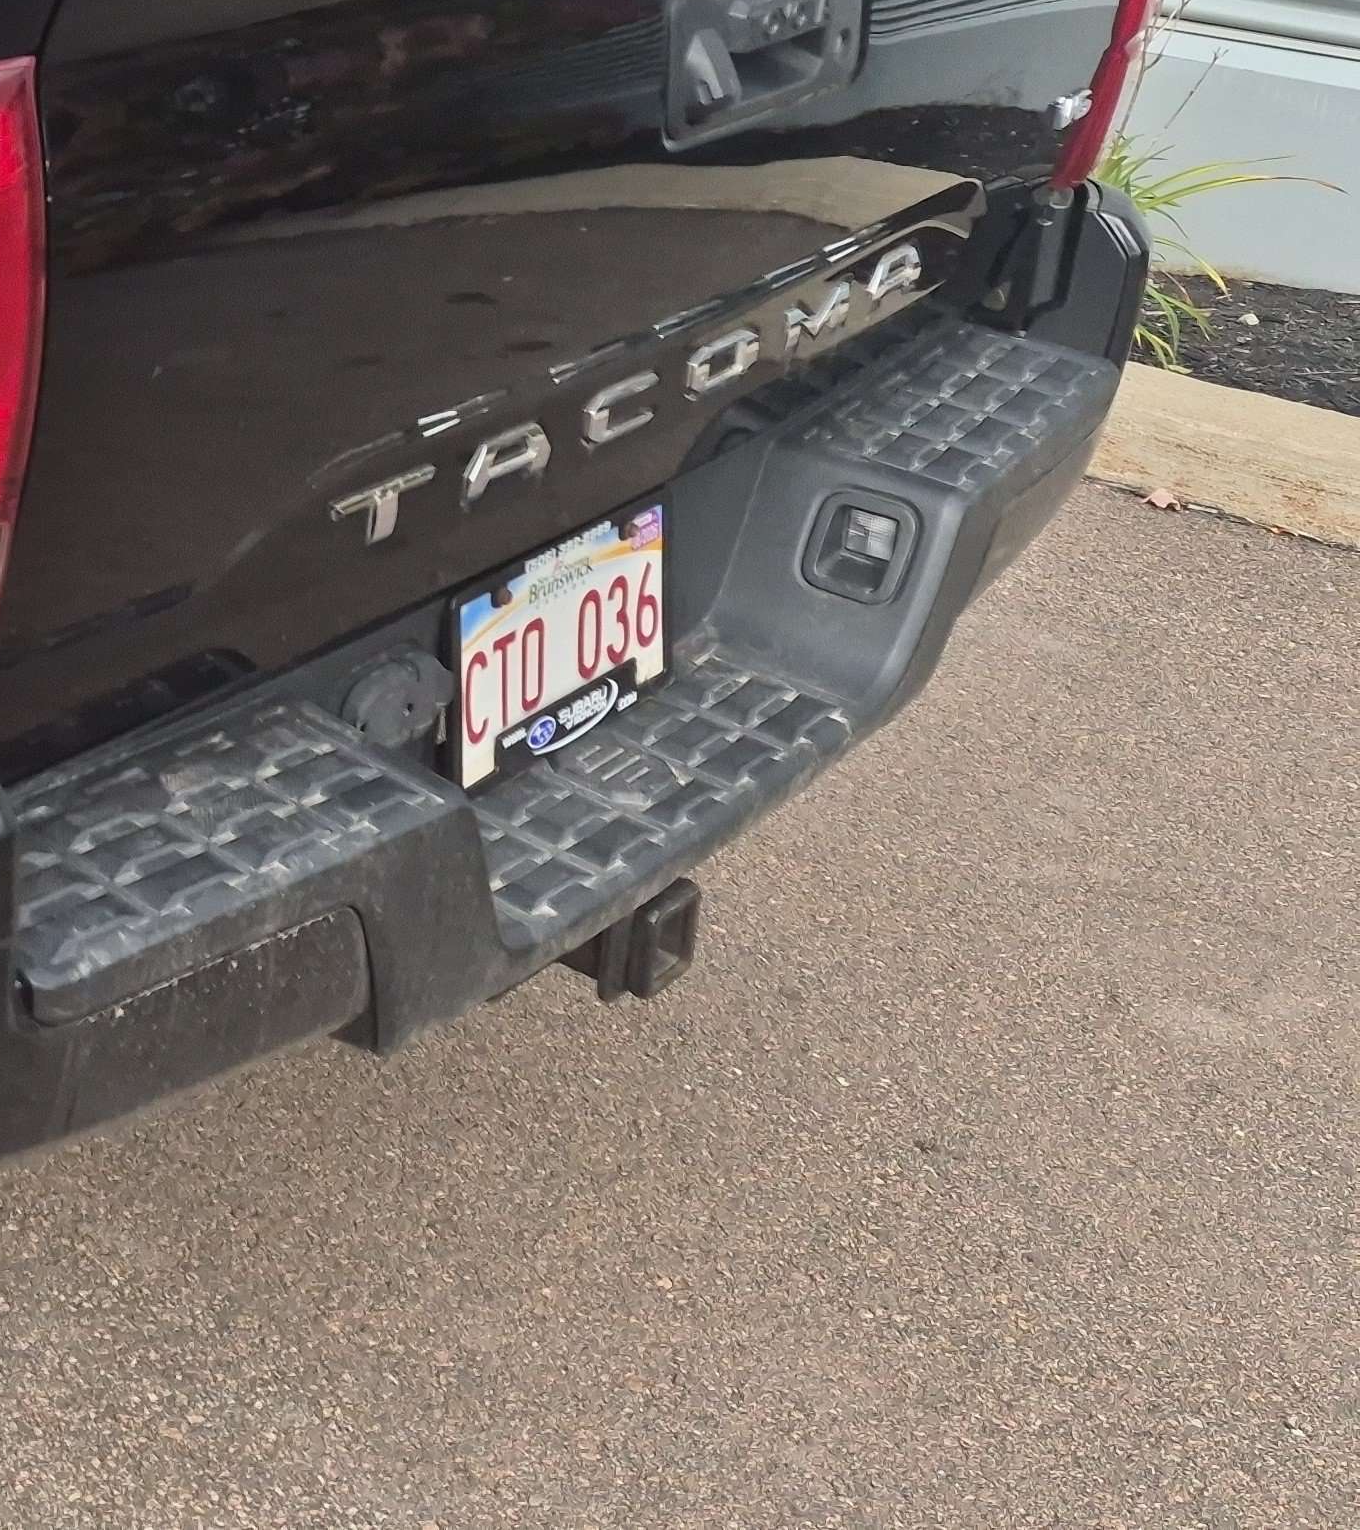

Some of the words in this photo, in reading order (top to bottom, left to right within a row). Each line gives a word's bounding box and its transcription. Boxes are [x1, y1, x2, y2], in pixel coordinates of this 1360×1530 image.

[329, 244, 923, 546] TACOMA
[465, 617, 545, 744] CTO
[577, 561, 659, 680] 036
